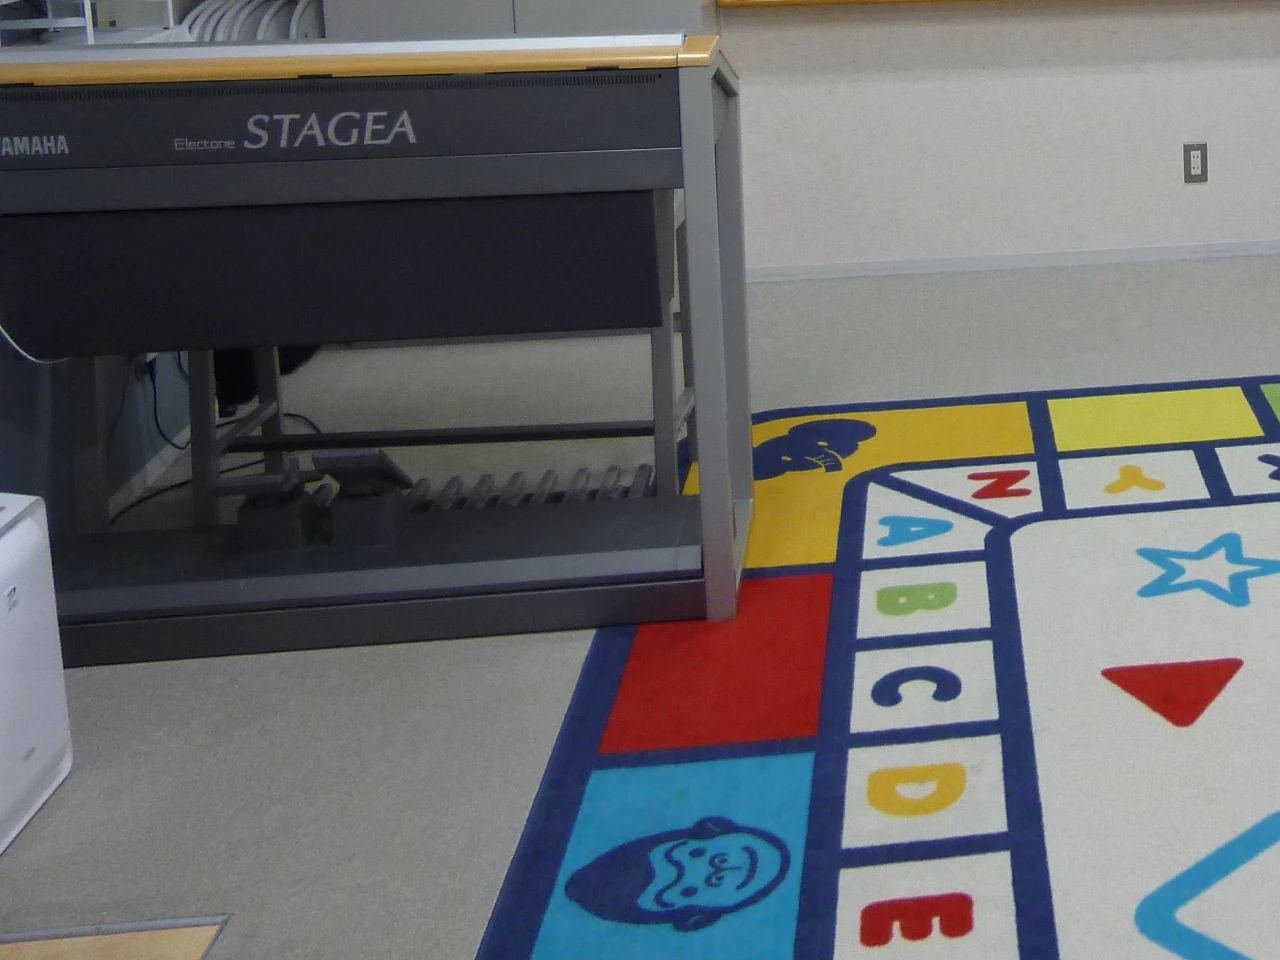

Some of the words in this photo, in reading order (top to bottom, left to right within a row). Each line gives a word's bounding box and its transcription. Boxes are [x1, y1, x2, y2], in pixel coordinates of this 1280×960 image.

[0, 135, 69, 156] AMAHA
[174, 137, 236, 151] Electone
[243, 110, 417, 150] STAGEA
[968, 470, 1030, 499] Z
[1104, 465, 1165, 495] Y
[878, 516, 953, 547] A
[878, 585, 954, 615] B
[872, 667, 961, 706] C
[867, 763, 966, 817] D
[860, 893, 974, 948] E
